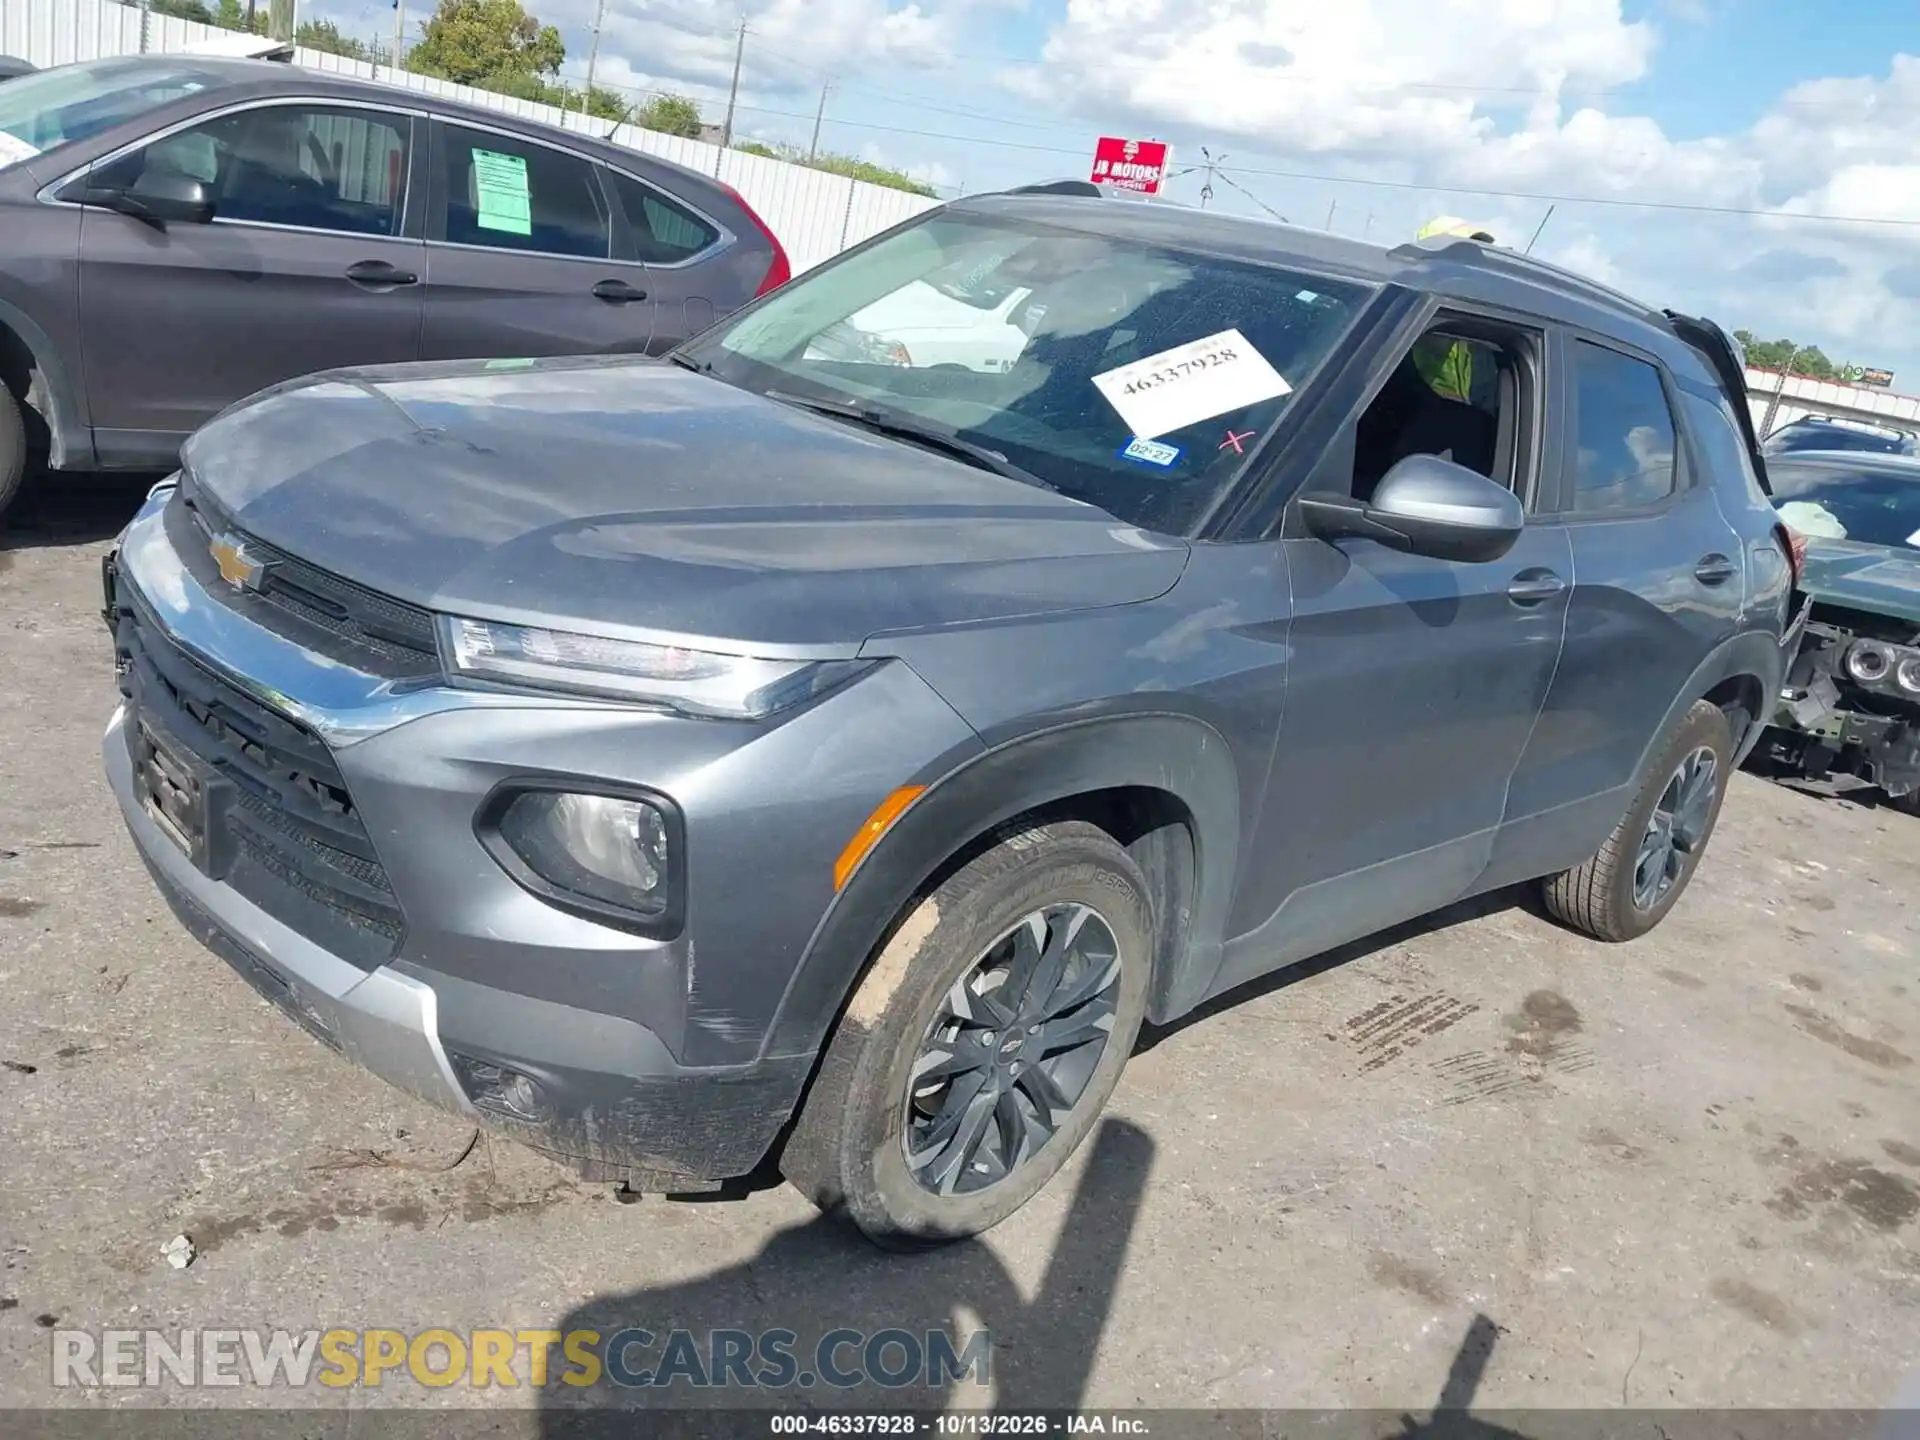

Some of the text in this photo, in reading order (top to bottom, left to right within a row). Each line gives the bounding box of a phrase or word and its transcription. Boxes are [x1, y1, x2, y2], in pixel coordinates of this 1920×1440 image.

[1094, 160, 1160, 179] JB MOTORS
[1123, 348, 1238, 395] 46337928
